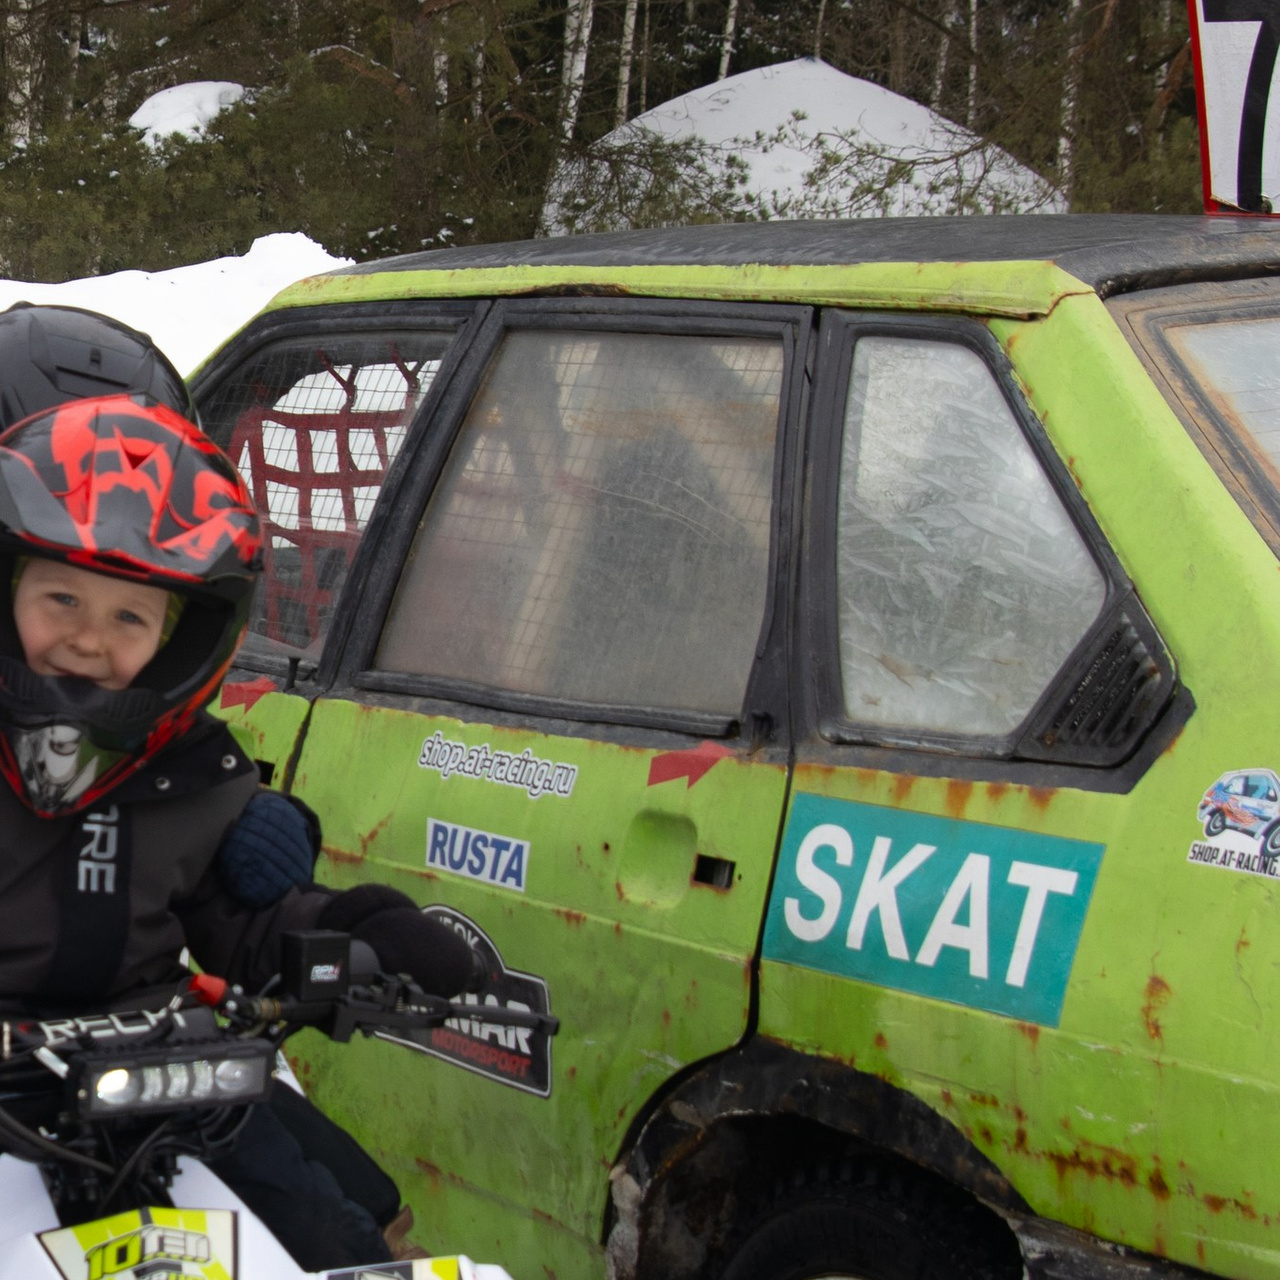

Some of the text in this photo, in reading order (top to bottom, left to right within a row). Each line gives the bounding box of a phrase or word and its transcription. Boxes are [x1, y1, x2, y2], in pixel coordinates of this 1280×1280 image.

[419, 732, 577, 798] shop.at-racing.ru
[428, 822, 524, 888] RUSTA
[1188, 843, 1280, 877] SHOP.AT-RACING.
[783, 823, 1079, 988] SKAT
